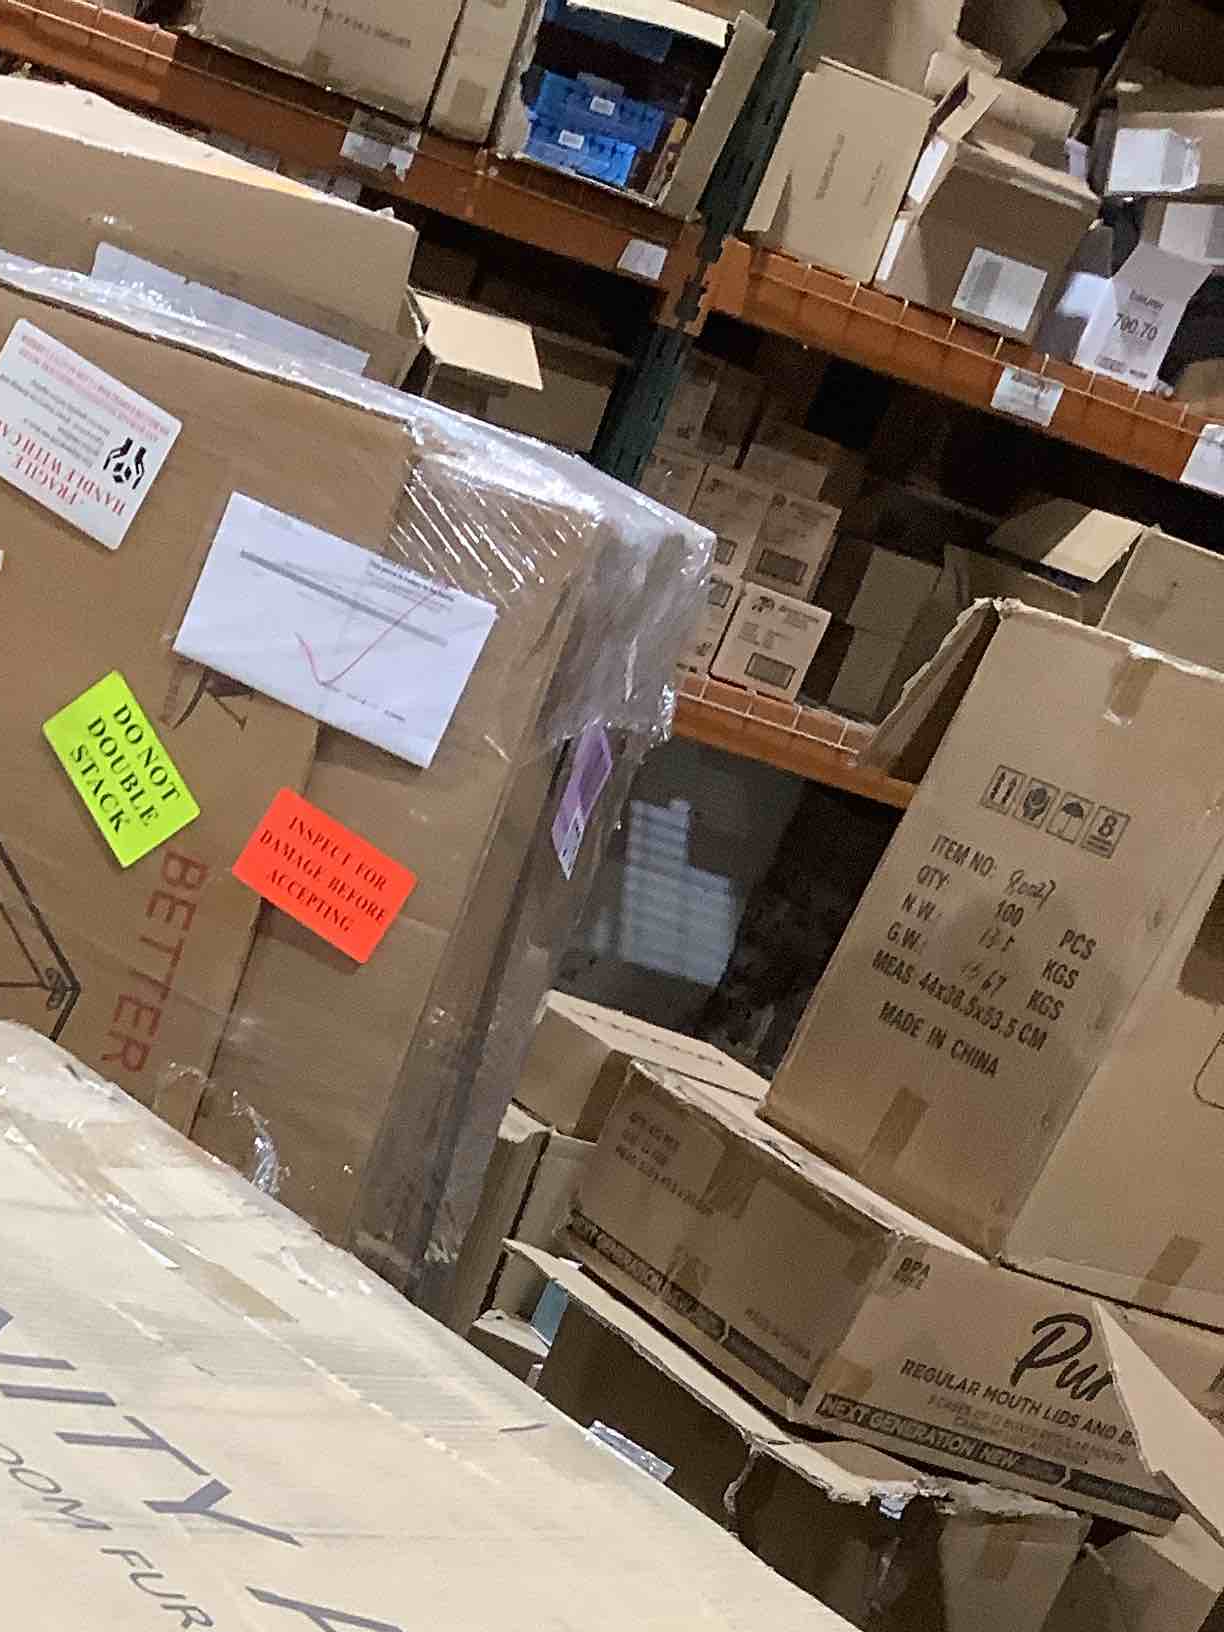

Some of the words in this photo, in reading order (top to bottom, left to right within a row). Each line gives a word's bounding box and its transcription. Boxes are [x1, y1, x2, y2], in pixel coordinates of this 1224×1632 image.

[15, 455, 78, 506] FRAGILE
[23, 436, 64, 475] WITH
[65, 467, 127, 517] HANDLE
[86, 714, 160, 828] DOUBLE
[112, 702, 144, 745] DO
[139, 744, 181, 802] NOT
[69, 742, 131, 833] STACK
[259, 828, 324, 885] DAMAGE
[326, 874, 388, 924] BEFORE
[287, 814, 356, 874] INSPECT
[354, 862, 390, 892] FOR
[930, 833, 970, 868] ITEM
[265, 868, 354, 934] ACCEPTING
[995, 899, 1025, 929] 100
[1059, 928, 1097, 961] PCS
[100, 850, 209, 1074] BETTER
[1041, 958, 1080, 990] KGS
[1017, 1022, 1048, 1052] CM
[1025, 989, 1065, 1022] KGS
[878, 1000, 926, 1040] MADE
[926, 1024, 948, 1051] IN
[950, 1037, 1001, 1079] CHINA
[899, 1256, 931, 1279] BPA
[821, 1395, 867, 1423] NEXT
[869, 1413, 976, 1459] GENERATION
[899, 1358, 982, 1403] REGULAR
[982, 1384, 1041, 1418] MOUTH
[1043, 1401, 1081, 1429] LIDS
[1079, 1415, 1118, 1440] AND
